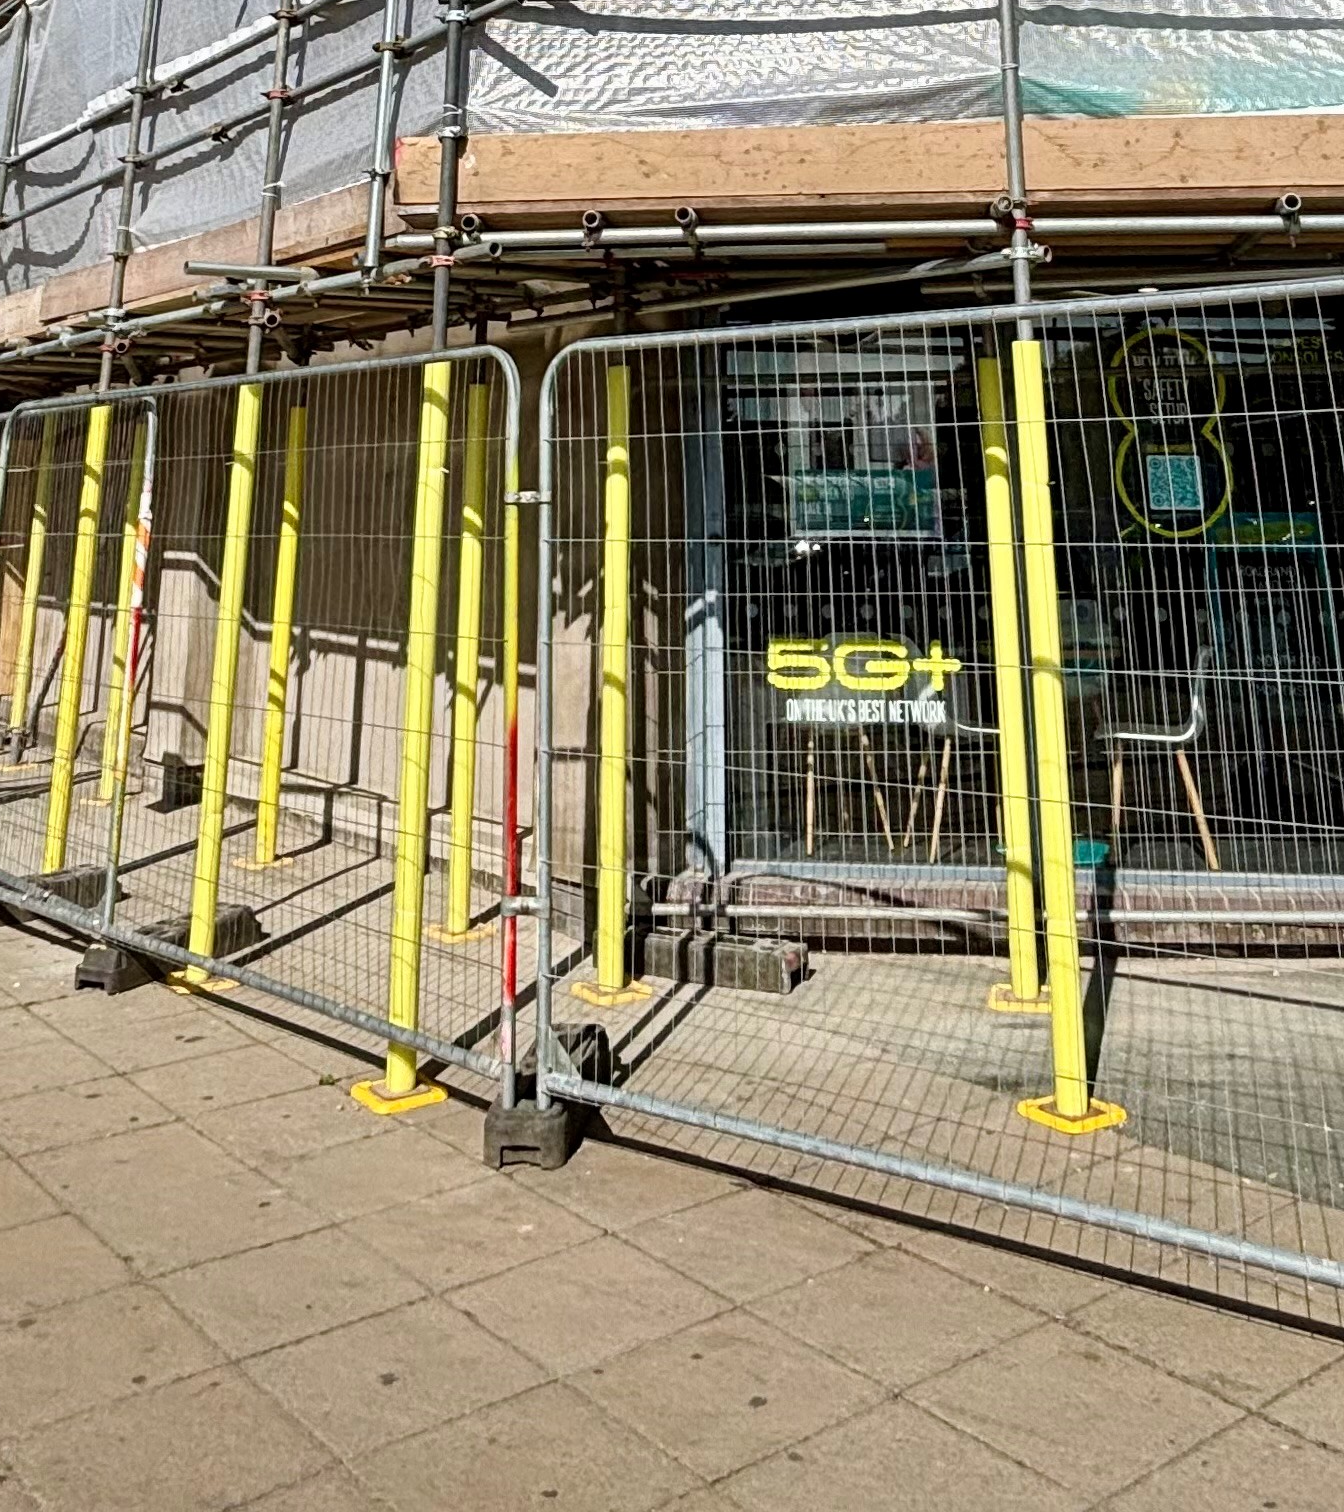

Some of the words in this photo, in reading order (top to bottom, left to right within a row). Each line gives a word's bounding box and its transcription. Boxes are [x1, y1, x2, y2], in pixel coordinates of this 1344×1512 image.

[767, 639, 962, 691] 5G+
[786, 698, 802, 722] ON
[802, 698, 827, 722] THE
[827, 698, 856, 723] UK'S
[858, 699, 886, 723] BEST
[889, 699, 947, 723] NETWORK
